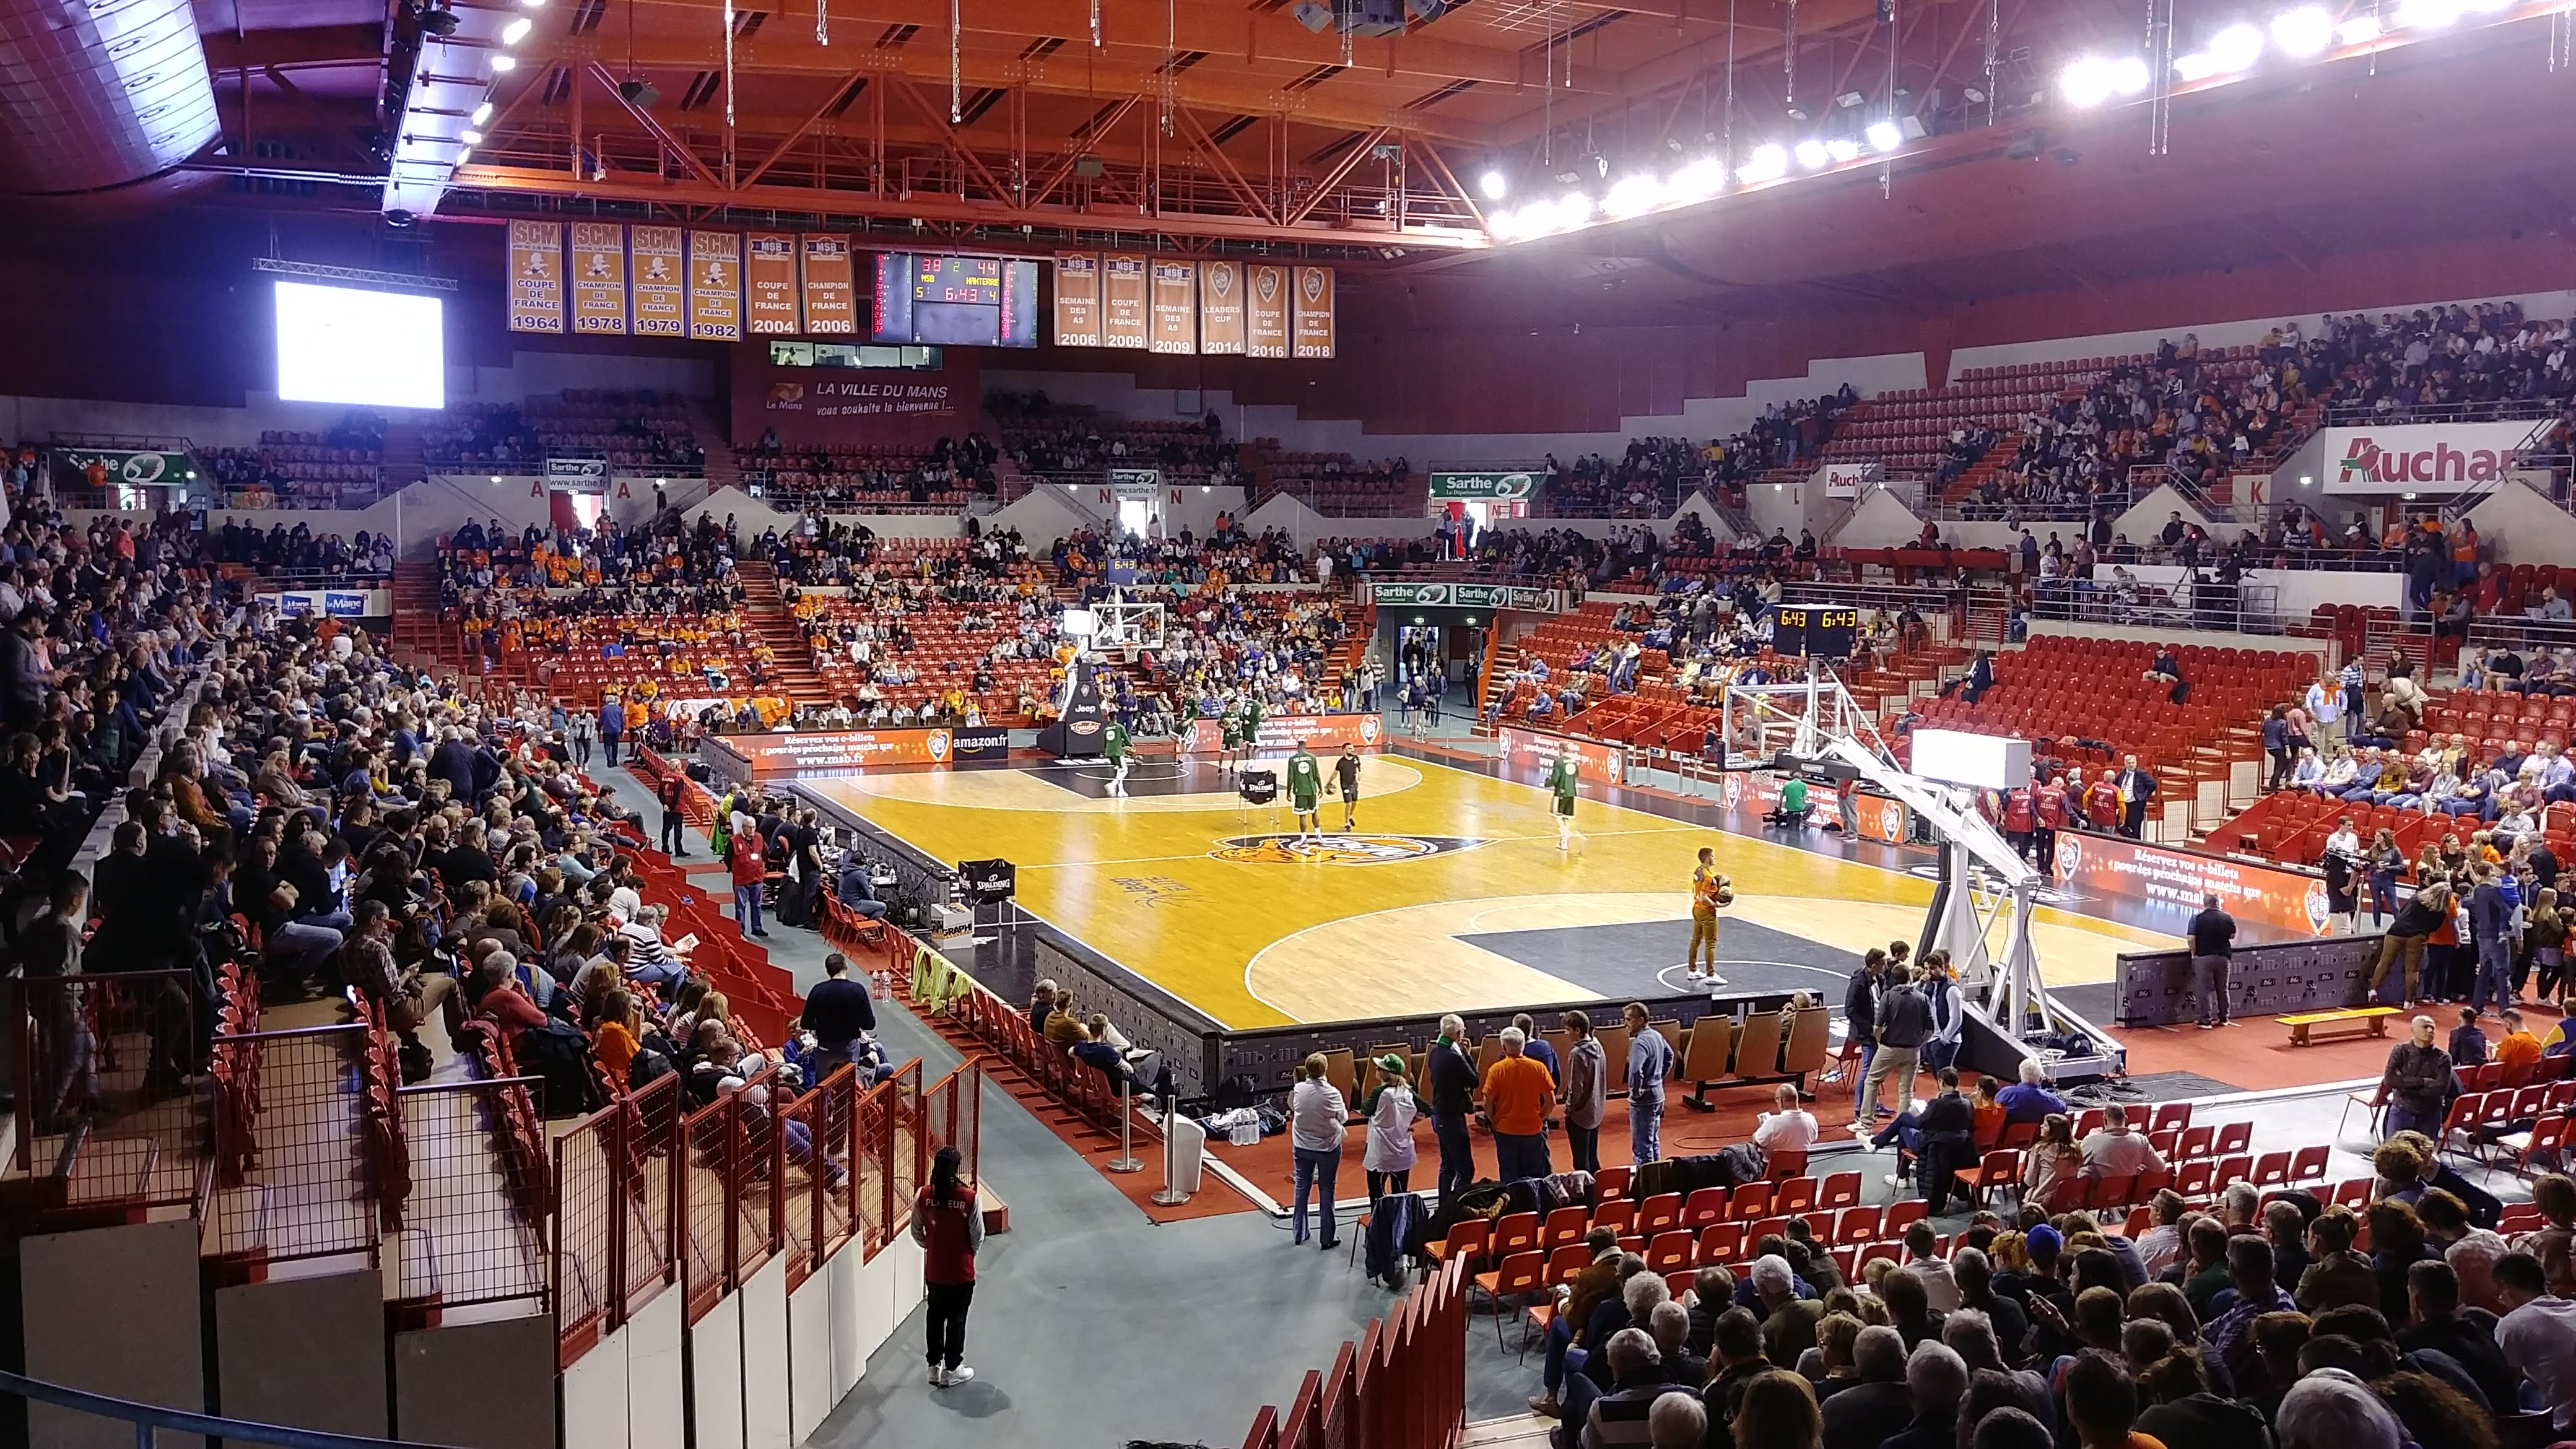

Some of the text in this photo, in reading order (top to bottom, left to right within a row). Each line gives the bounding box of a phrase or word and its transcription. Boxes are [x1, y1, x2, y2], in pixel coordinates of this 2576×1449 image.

[515, 222, 557, 245] SCM
[577, 223, 619, 246] SCM
[637, 227, 678, 249] SCM
[695, 233, 736, 255] SCM
[761, 242, 782, 251] MSB
[816, 243, 837, 252] MSB
[923, 259, 996, 275] 38 2 44
[1068, 259, 1087, 269] MSB
[1116, 262, 1134, 271] MSB
[1164, 268, 1182, 277] MSB
[518, 280, 555, 289] COUPE
[757, 282, 788, 290] COUPE
[966, 277, 999, 286] NANTERRE
[990, 291, 996, 301] 4
[515, 300, 559, 309] FRANCE
[1155, 305, 1190, 313] SEMAINE
[513, 316, 559, 329] 1964
[578, 317, 622, 329] 1978
[637, 320, 680, 331] 1979
[754, 320, 794, 333] 2004
[811, 320, 851, 333] 2006
[694, 324, 736, 337] 1982
[1061, 334, 1097, 346] 2006
[1108, 336, 1143, 347] 2009
[1155, 341, 1190, 353] 2009
[1208, 342, 1241, 353] 2014
[1251, 346, 1284, 357] 2016
[1298, 346, 1329, 357] 2018
[816, 383, 948, 398] LA VILLE DU MANS
[766, 401, 803, 410] Le Mans
[817, 406, 837, 416] vous
[842, 402, 880, 415] souhaite
[884, 402, 892, 412] la
[897, 401, 939, 412] bienvenue
[69, 453, 119, 471] Sarhe
[2338, 438, 2516, 483] Aucha
[551, 463, 579, 471] Sarthe
[550, 479, 606, 487] www.sarthe.fr
[1447, 476, 1492, 489] Sarthe
[1829, 472, 1860, 487] Auch
[530, 481, 544, 497] A
[617, 482, 631, 498] A
[2251, 481, 2263, 504] K
[1100, 489, 1111, 503] N
[1170, 490, 1182, 504] N
[1795, 488, 1799, 505] L
[1375, 586, 1414, 596] Sarthe
[1458, 587, 1488, 599] Sarthe
[333, 599, 361, 608] Maine
[1781, 610, 1806, 627] 6:43
[1822, 612, 1856, 627] 6:43
[1075, 704, 1095, 713] Jeep
[1076, 723, 1099, 733] Gaulois
[784, 736, 823, 744] Réservez
[841, 733, 875, 742] e-billets
[953, 734, 1007, 748] amazon.fr
[803, 744, 846, 755] prochains
[847, 742, 878, 751] matchs
[796, 753, 865, 765] www.msb.fr
[2134, 848, 2239, 880] Réservez vos e-billets
[977, 879, 1011, 890] SPALDING
[2153, 868, 2203, 887] prochains
[2204, 878, 2242, 895] matchs
[2243, 887, 2261, 899] sur
[925, 1198, 966, 1209] PLEUR
